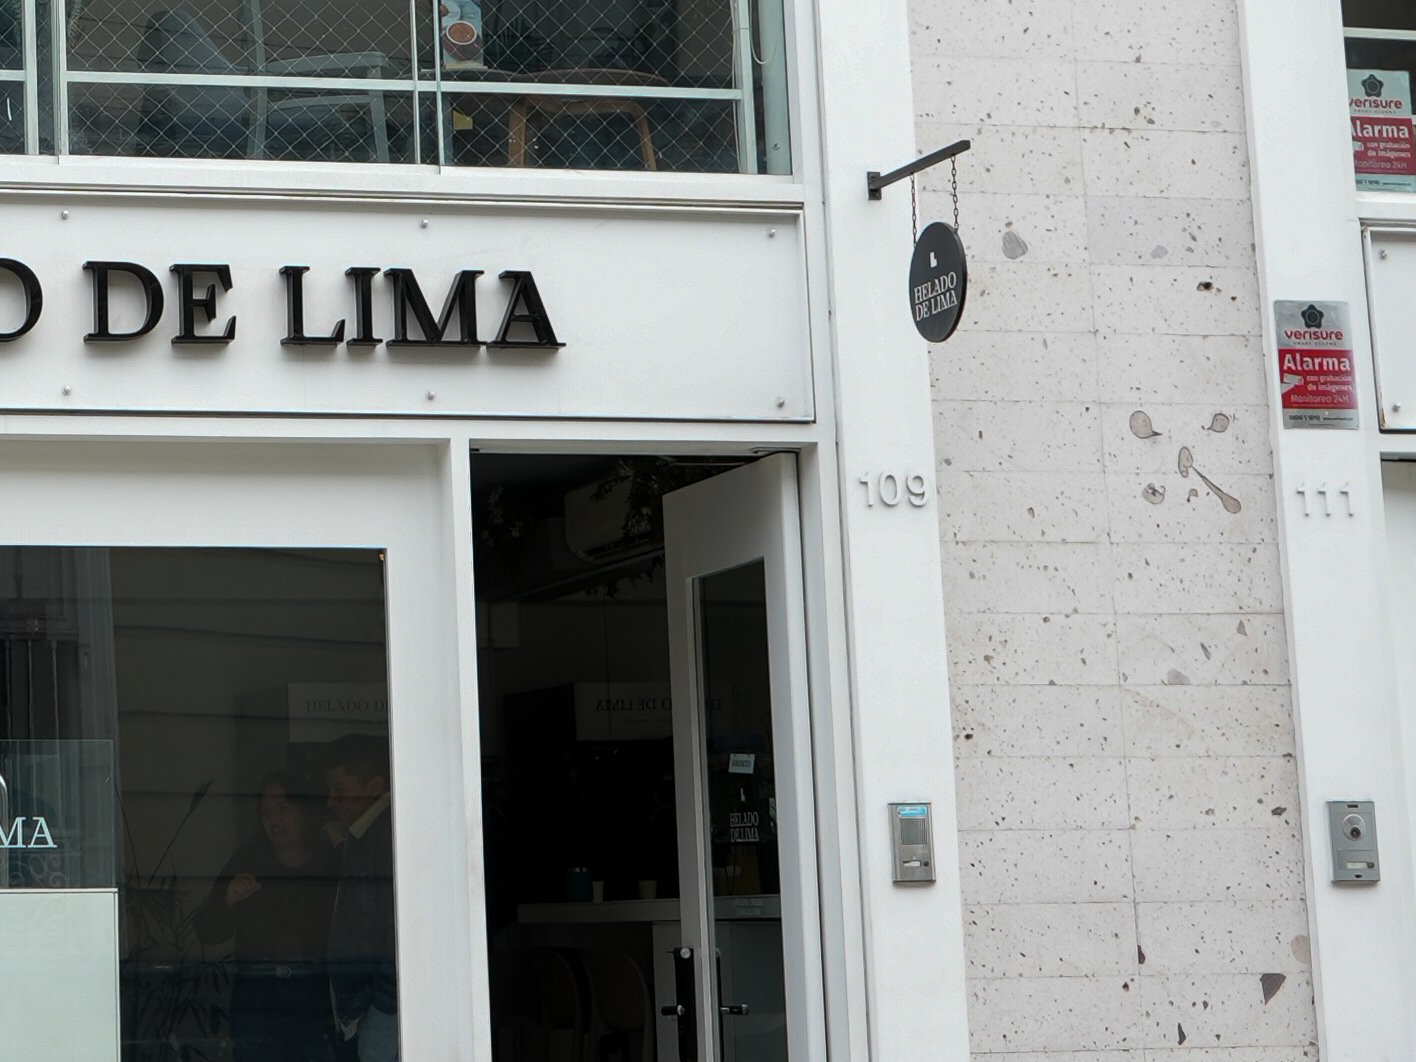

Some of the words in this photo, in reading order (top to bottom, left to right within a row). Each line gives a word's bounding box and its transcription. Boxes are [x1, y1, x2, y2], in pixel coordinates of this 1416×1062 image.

[914, 271, 957, 304] HELADO
[83, 260, 236, 346] DE
[278, 265, 566, 351] LIMA
[915, 300, 930, 321] DE
[931, 289, 958, 315] LIMA
[1284, 330, 1344, 341] verisure
[1284, 353, 1351, 371] Alarma
[858, 471, 928, 508] 109
[1296, 482, 1354, 518] 111
[306, 700, 369, 713] HELADO
[729, 811, 759, 827] HELADO
